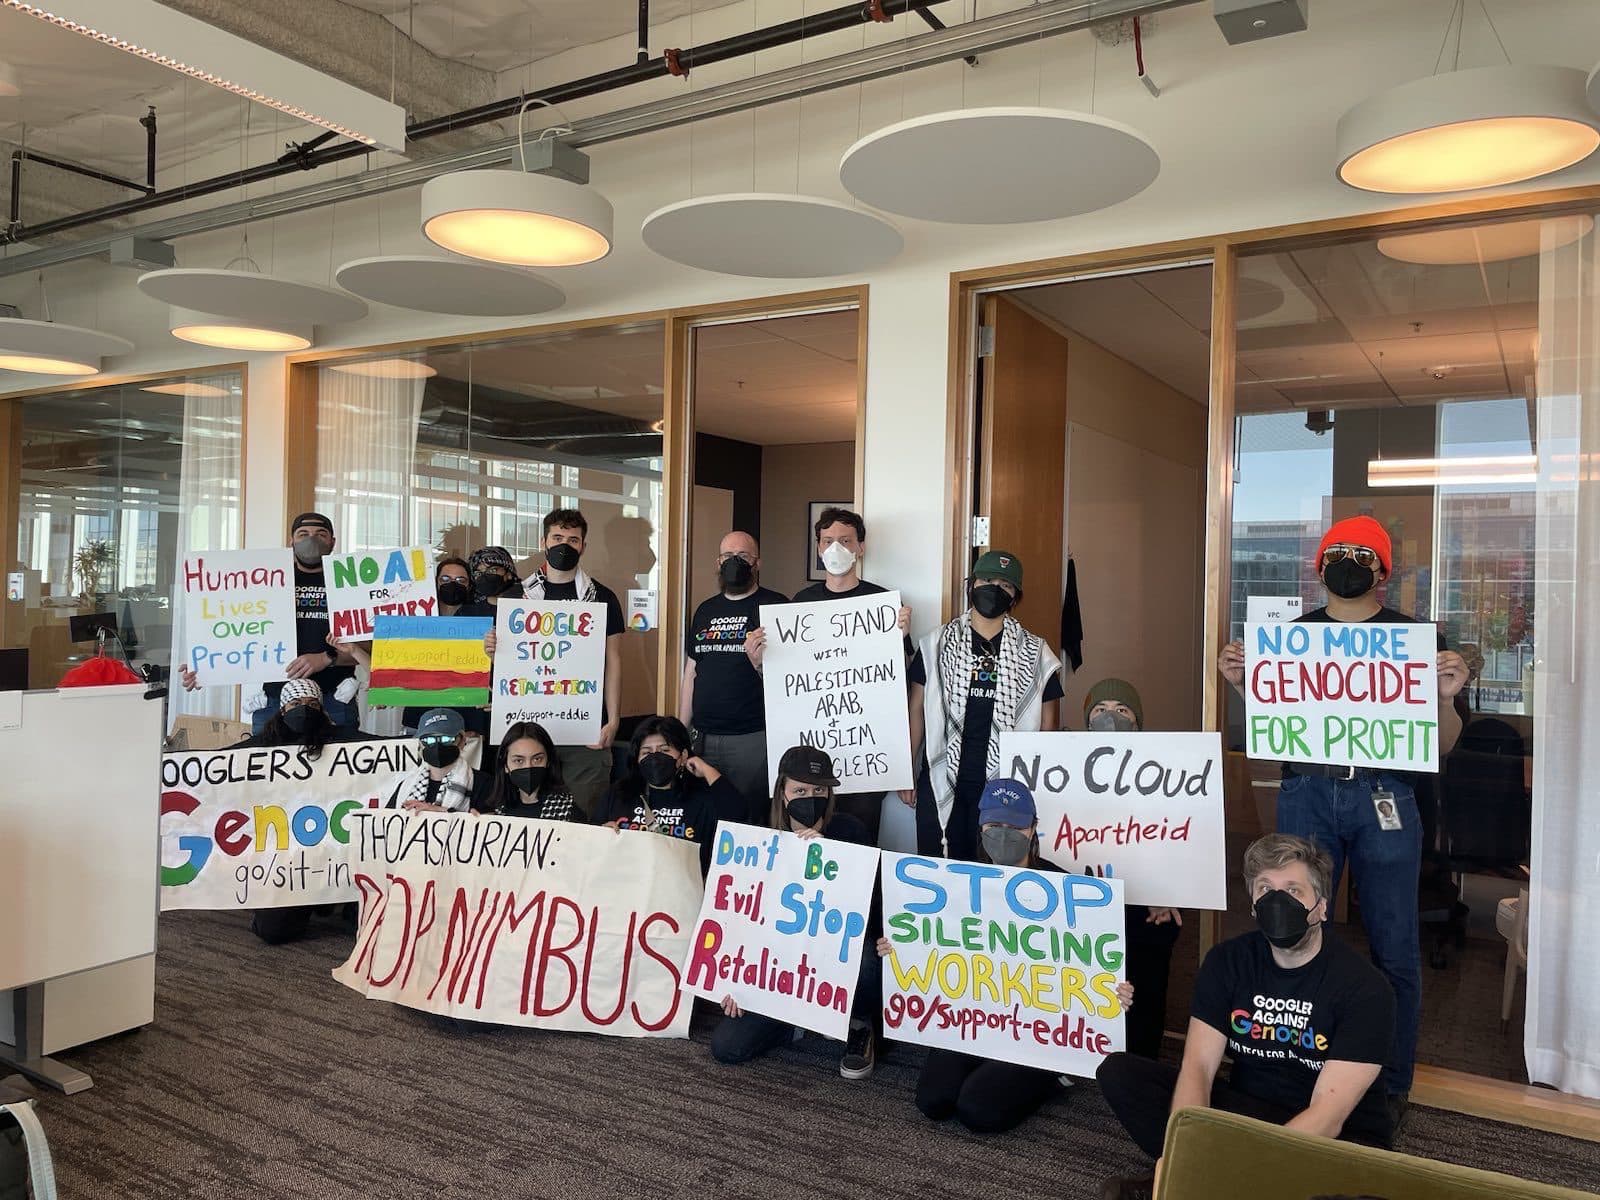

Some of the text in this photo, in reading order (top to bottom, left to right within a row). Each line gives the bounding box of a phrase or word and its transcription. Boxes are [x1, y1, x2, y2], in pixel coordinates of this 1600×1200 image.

[184, 558, 286, 593] Human
[333, 550, 426, 589] NO AI
[202, 597, 270, 620] Lives
[369, 588, 390, 600] FOR
[508, 608, 594, 636] GOOGLE:
[709, 623, 745, 632] AGAINST
[710, 616, 748, 625] GOOGLER
[776, 605, 897, 643] WE STAND
[1267, 611, 1281, 619] VPC
[191, 641, 287, 673] Profit
[516, 641, 572, 661] STOP
[1257, 626, 1409, 661] NO MORE
[499, 678, 597, 696] RETALIATION
[534, 665, 557, 675] the
[785, 659, 896, 697] PALESTINIAN,
[1251, 660, 1429, 705] GENOCIDE
[505, 708, 590, 724] go/support-eddie
[815, 691, 863, 718] ARAB,
[800, 723, 876, 749] MUSLIM
[1250, 715, 1437, 762] FOR PROFIT
[162, 745, 422, 787] OOGLERS AGAIN
[832, 753, 889, 779] GLERS
[1011, 755, 1070, 793] No
[616, 816, 695, 838] encide
[632, 816, 681, 825] AGINST
[634, 806, 684, 817] GOGLER
[1054, 813, 1191, 860] Apartheid
[716, 830, 839, 881] Don't Be
[235, 851, 350, 904] go/sit-in
[895, 856, 1113, 929] STOP
[775, 882, 865, 963] Stop
[427, 888, 682, 1031] NIMBUS
[888, 912, 1124, 972] SILENCING
[686, 919, 848, 1014] Retaliation
[889, 947, 1122, 1019] WORKERS
[1252, 1009, 1309, 1029] AGAINST
[1253, 995, 1313, 1015] GOOGLER
[884, 992, 1112, 1056] go/support-eddie
[1231, 1008, 1328, 1051] Genocide
